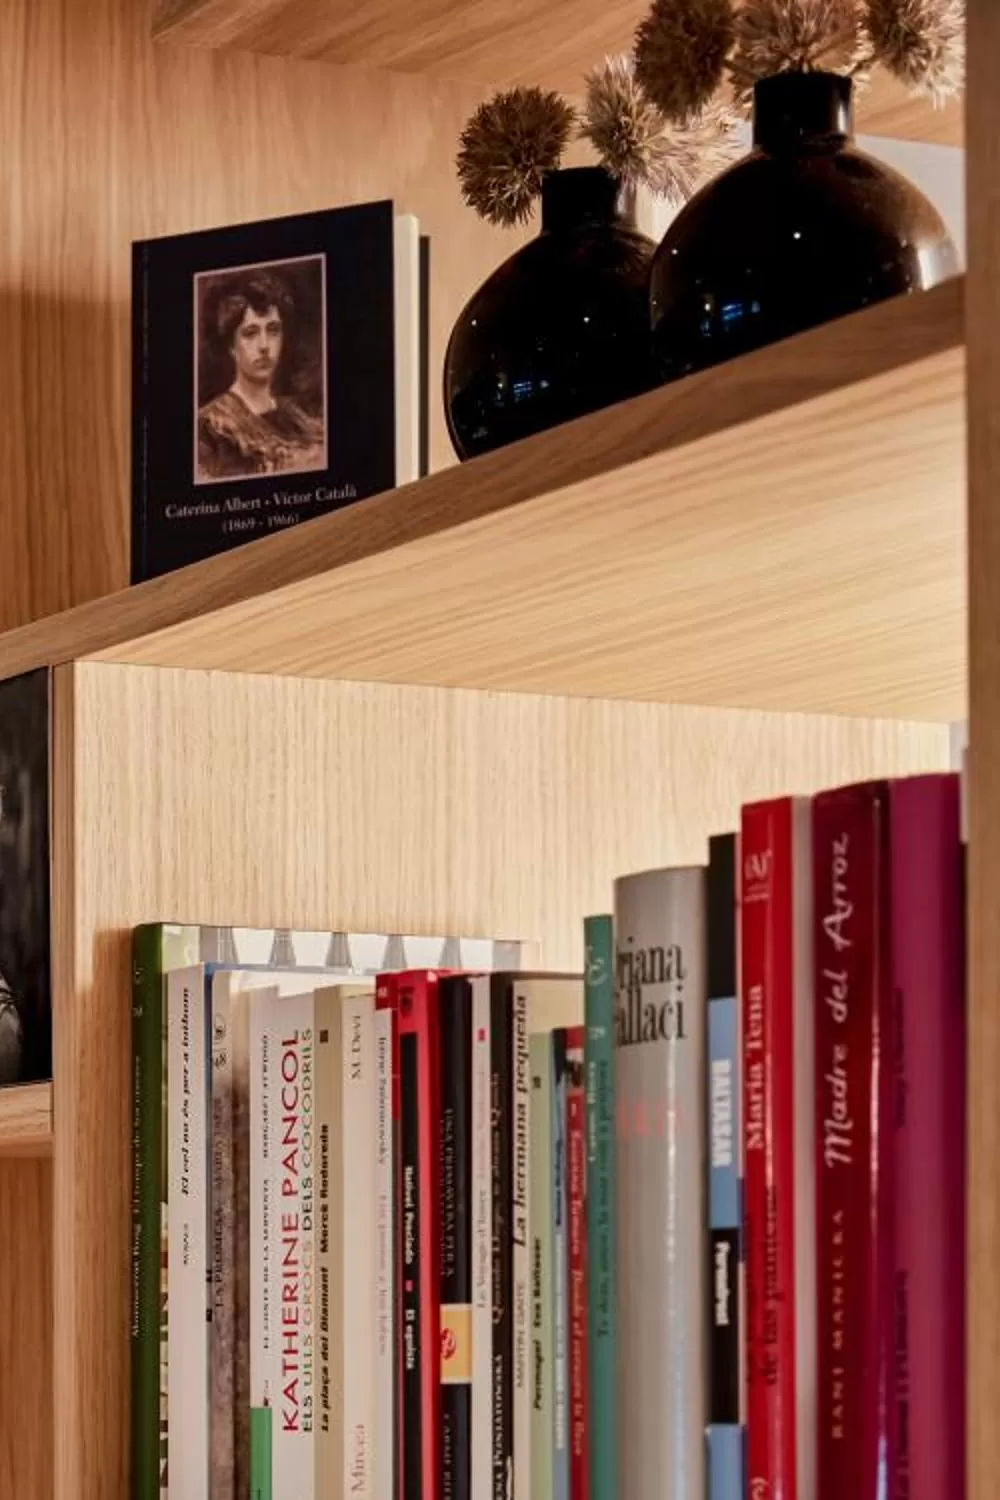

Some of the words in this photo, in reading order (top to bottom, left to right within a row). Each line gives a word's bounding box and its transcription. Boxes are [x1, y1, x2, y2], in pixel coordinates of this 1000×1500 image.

[165, 503, 221, 518] Caterina
[223, 497, 261, 513] Albert
[821, 831, 854, 952] Arroz
[747, 984, 763, 1051] Tena
[822, 967, 849, 1025] del
[351, 1014, 362, 1054] Devi
[513, 994, 529, 1094] pequeña
[281, 1028, 299, 1197] PANCOL
[302, 1028, 312, 1169] COCODRILS
[711, 1058, 731, 1167] BALTASAR
[823, 1043, 854, 1169] Madre
[319, 1123, 329, 1200] Rodoreda
[511, 1102, 526, 1209] hermana
[182, 1175, 190, 1197] El
[302, 1177, 312, 1232] DELS
[319, 1203, 329, 1254] Mercè
[405, 1211, 415, 1265] Preciado
[511, 1217, 526, 1249] La
[302, 1241, 312, 1326] GROCS
[320, 1267, 329, 1333] Diamant
[281, 1212, 299, 1433] KATHERINE
[406, 1309, 417, 1321] El
[302, 1333, 312, 1387] ULLS
[320, 1337, 329, 1362] del
[302, 1395, 312, 1433] ELS
[320, 1366, 331, 1412] plaça
[320, 1412, 329, 1433] La
